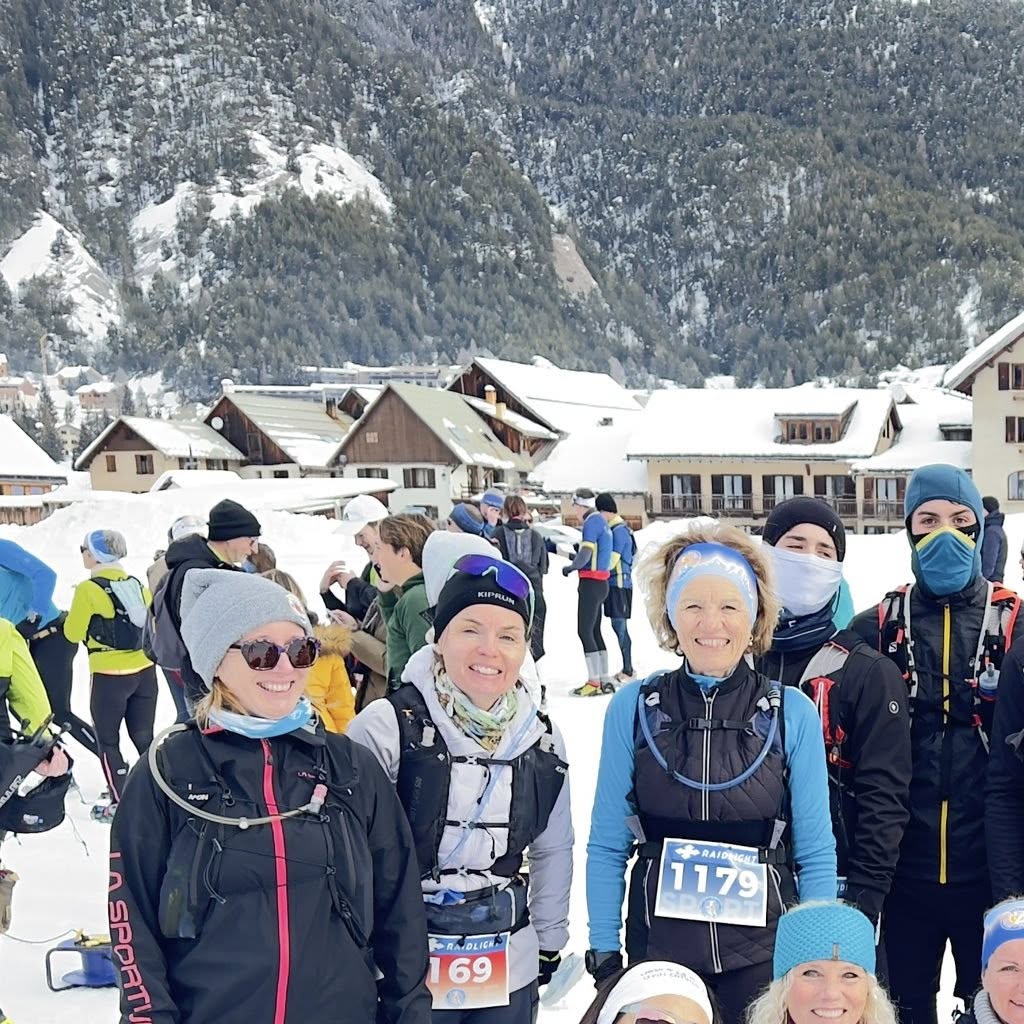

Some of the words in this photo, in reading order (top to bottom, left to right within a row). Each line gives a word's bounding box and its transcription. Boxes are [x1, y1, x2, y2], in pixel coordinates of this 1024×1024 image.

[477, 591, 515, 605] KIPRUN
[701, 849, 757, 863] RAIDLIGHT
[671, 862, 760, 898] 1179
[446, 940, 499, 951] RAIDLIGH
[429, 956, 493, 984] 169
